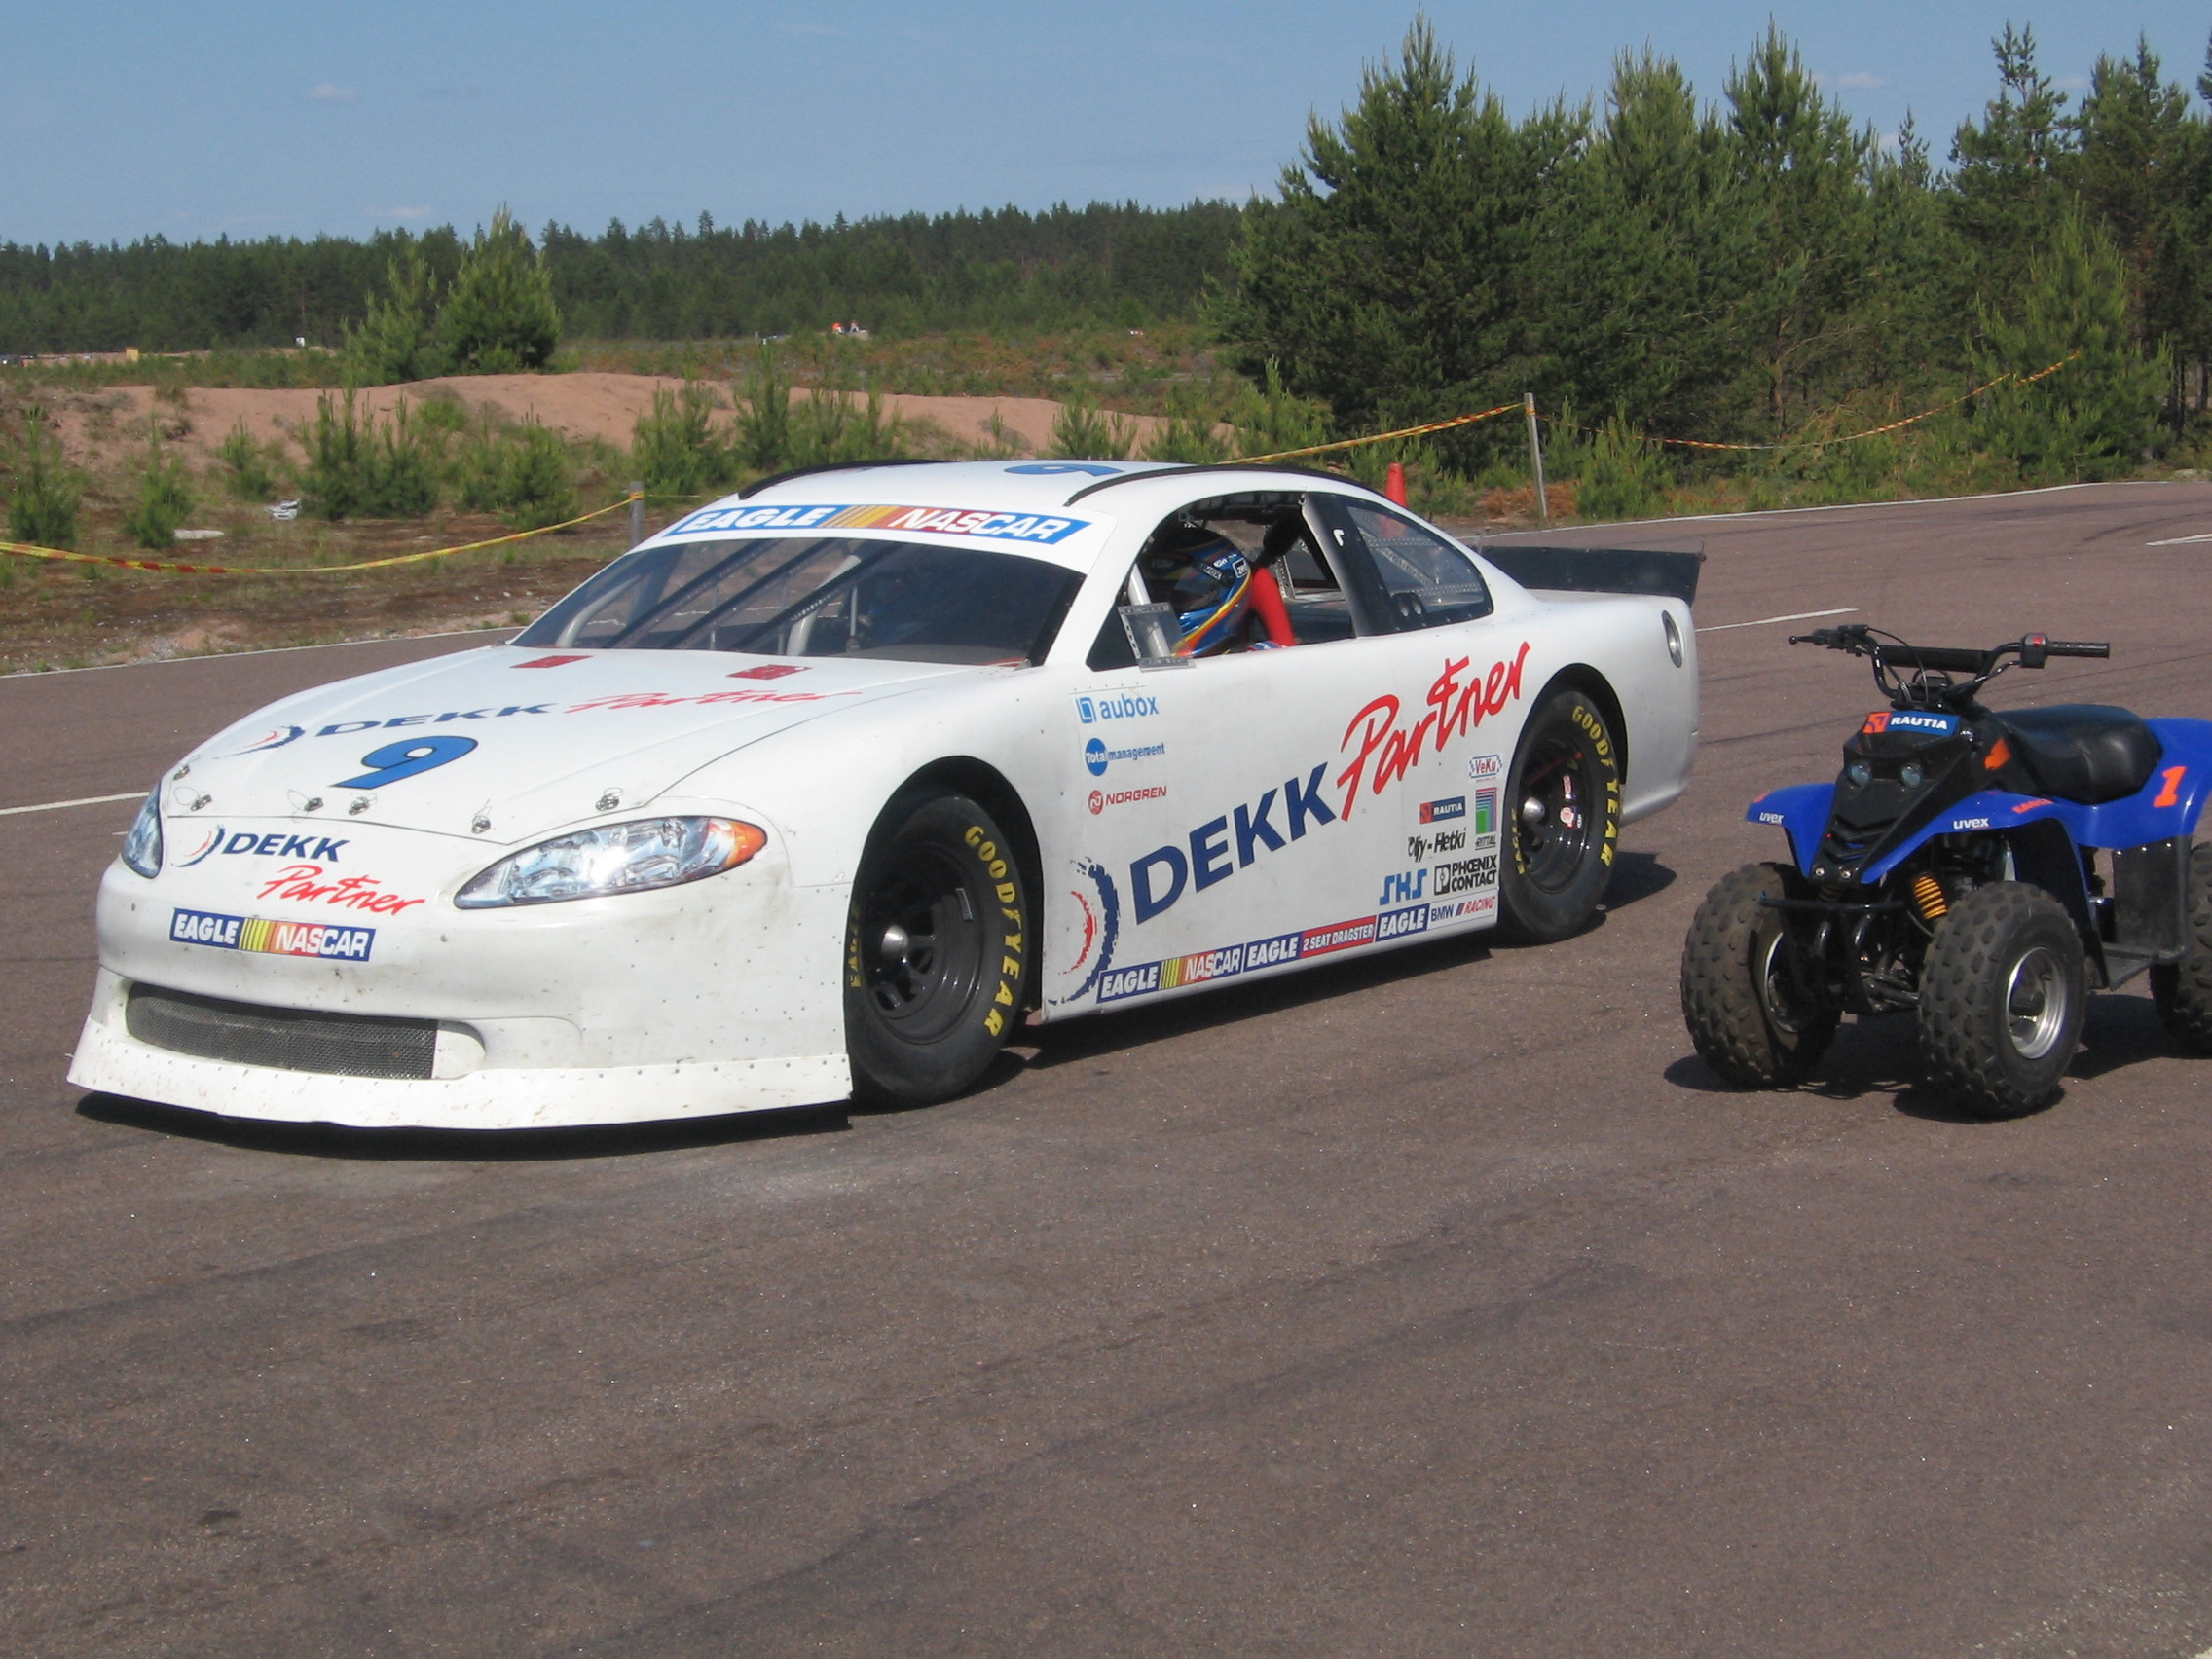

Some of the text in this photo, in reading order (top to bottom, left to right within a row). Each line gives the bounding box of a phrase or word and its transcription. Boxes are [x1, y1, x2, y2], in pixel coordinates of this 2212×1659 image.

[689, 507, 1071, 540] EAGLE NASCAR
[315, 702, 555, 737] DEKK
[1098, 693, 1160, 720] aubox
[1890, 715, 1948, 730] RAUTIA
[1337, 641, 1530, 822] Partner
[329, 735, 479, 791] 9
[1108, 743, 1166, 761] management
[1106, 786, 1167, 807] NORGREN
[2152, 765, 2187, 808] 1
[1433, 801, 1464, 816] RAUTIA
[1758, 812, 1785, 825] uvex
[1953, 817, 1990, 830] uvex
[222, 832, 350, 863] DEKK
[1129, 761, 1337, 925] DEKK
[256, 864, 426, 916] Partner
[1451, 869, 1497, 893] CONTACT
[173, 912, 370, 958] EAGLE NASCAR
[965, 826, 1023, 1038] GOODYEAR
[1101, 896, 1496, 998] EAGLE NASCAR EAGLE 2 SEAT DRAGSTER EAGLE BMW RACING
